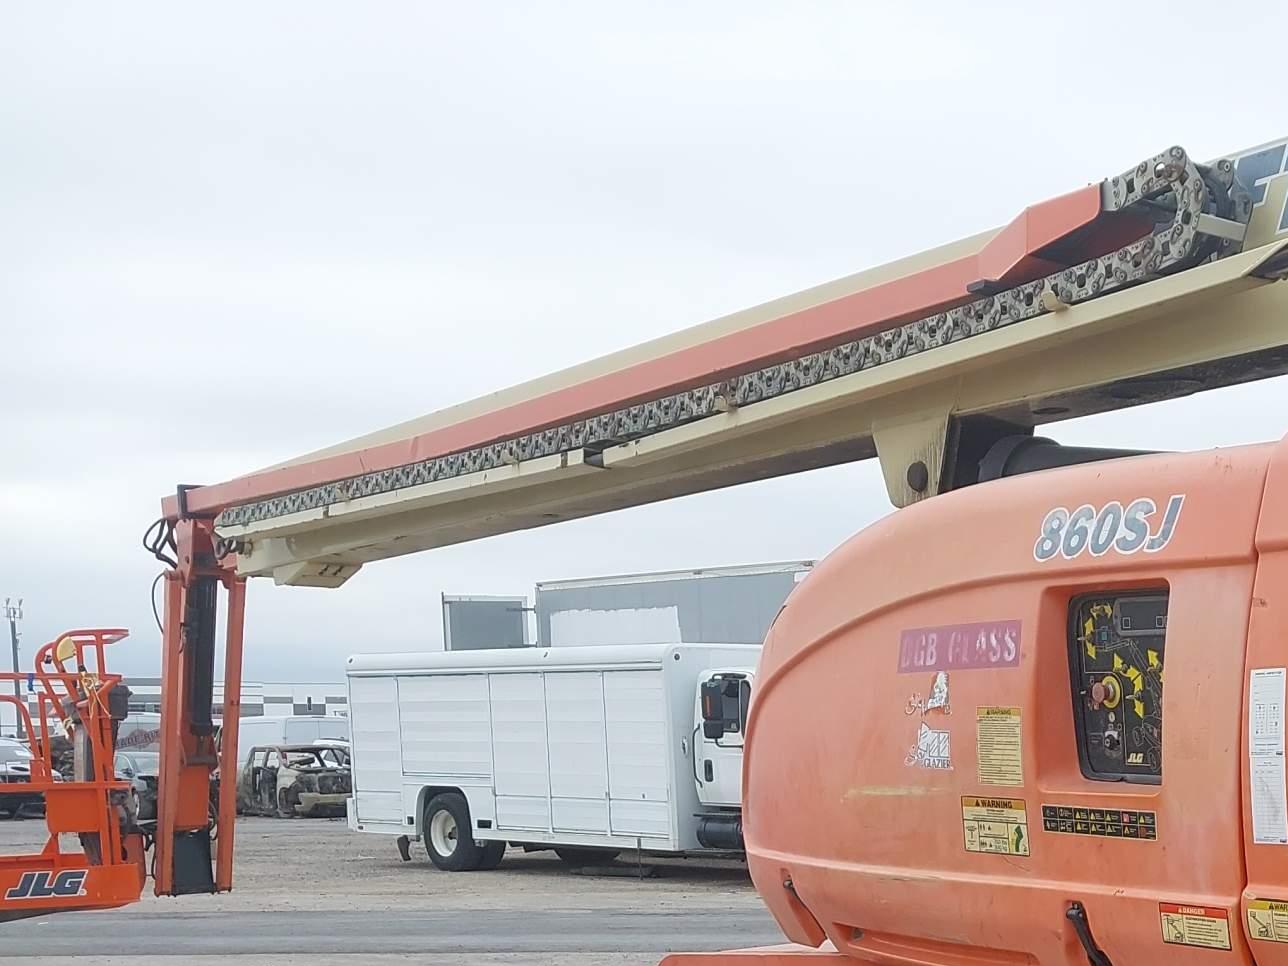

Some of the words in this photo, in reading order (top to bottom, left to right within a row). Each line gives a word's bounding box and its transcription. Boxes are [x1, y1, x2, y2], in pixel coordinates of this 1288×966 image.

[1033, 494, 1186, 562] 860SJ
[1127, 753, 1144, 763] JLG
[924, 758, 951, 769] GLAZIER
[980, 799, 1013, 809] WARNING
[5, 870, 89, 900] JLG
[1182, 907, 1205, 916] DANGER
